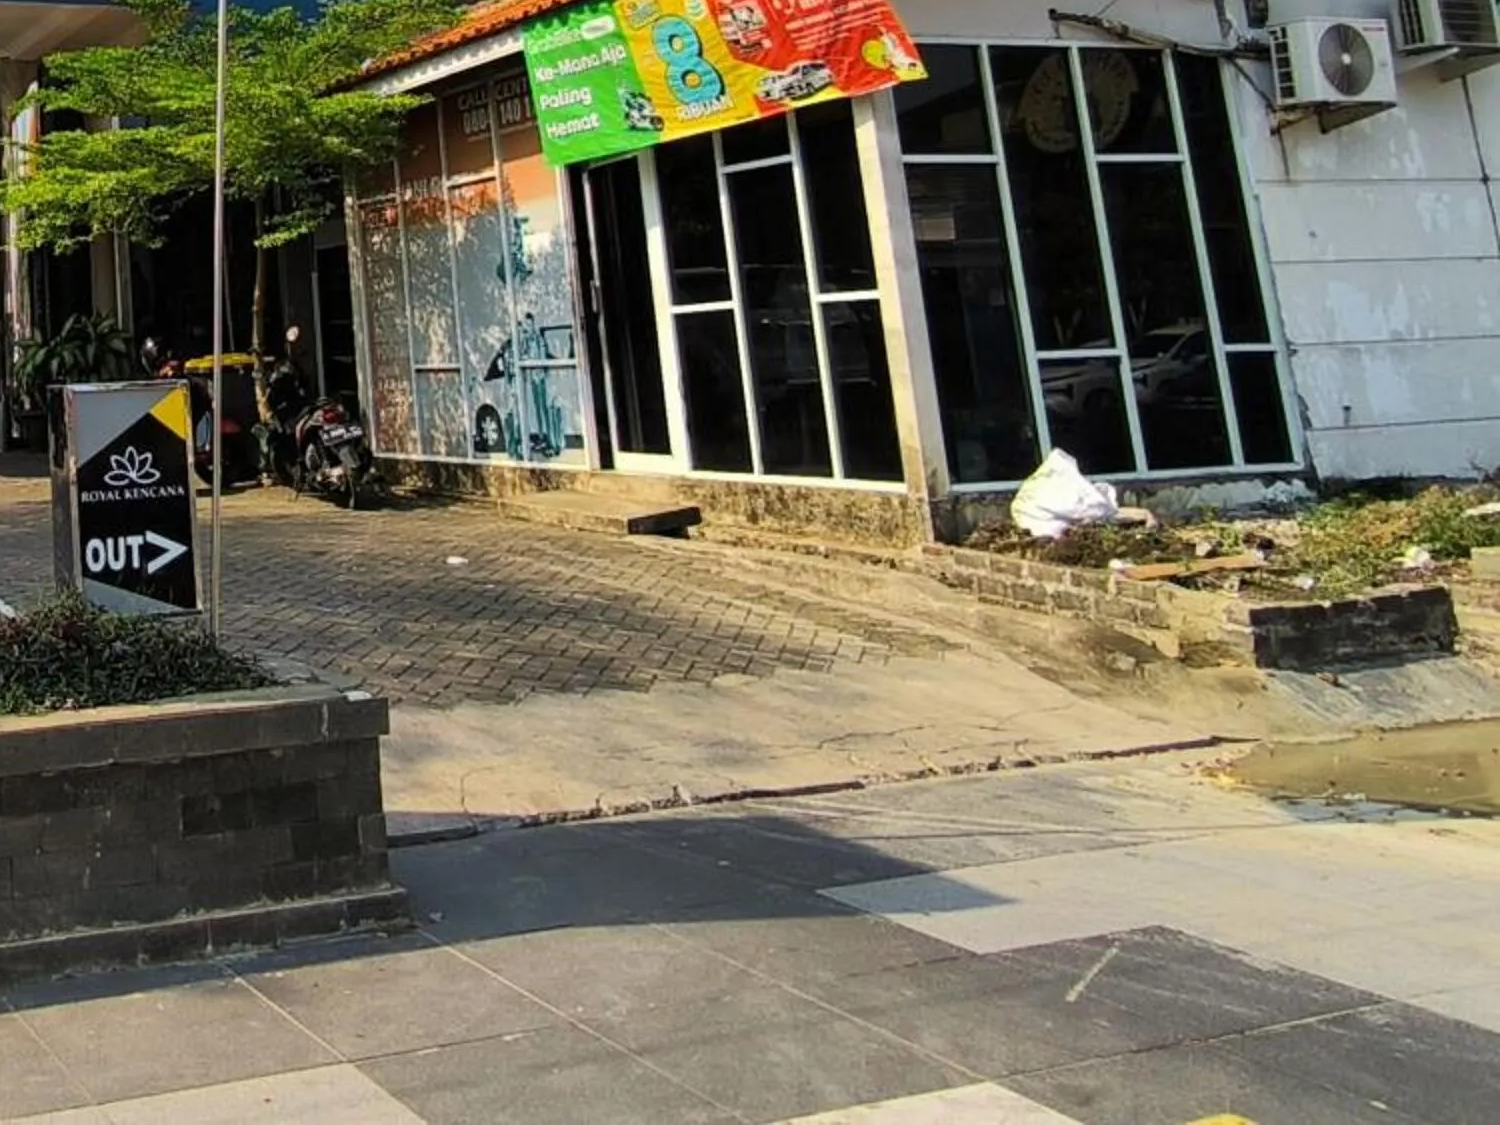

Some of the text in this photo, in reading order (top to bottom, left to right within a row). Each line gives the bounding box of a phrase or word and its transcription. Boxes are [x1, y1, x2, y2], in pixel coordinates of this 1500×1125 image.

[652, 13, 726, 106] 8
[496, 76, 527, 100] CENT
[539, 86, 593, 110] Paling
[546, 112, 600, 139] Hemat
[81, 486, 185, 503] ROYAL KENCANA
[85, 535, 144, 572] OUT
